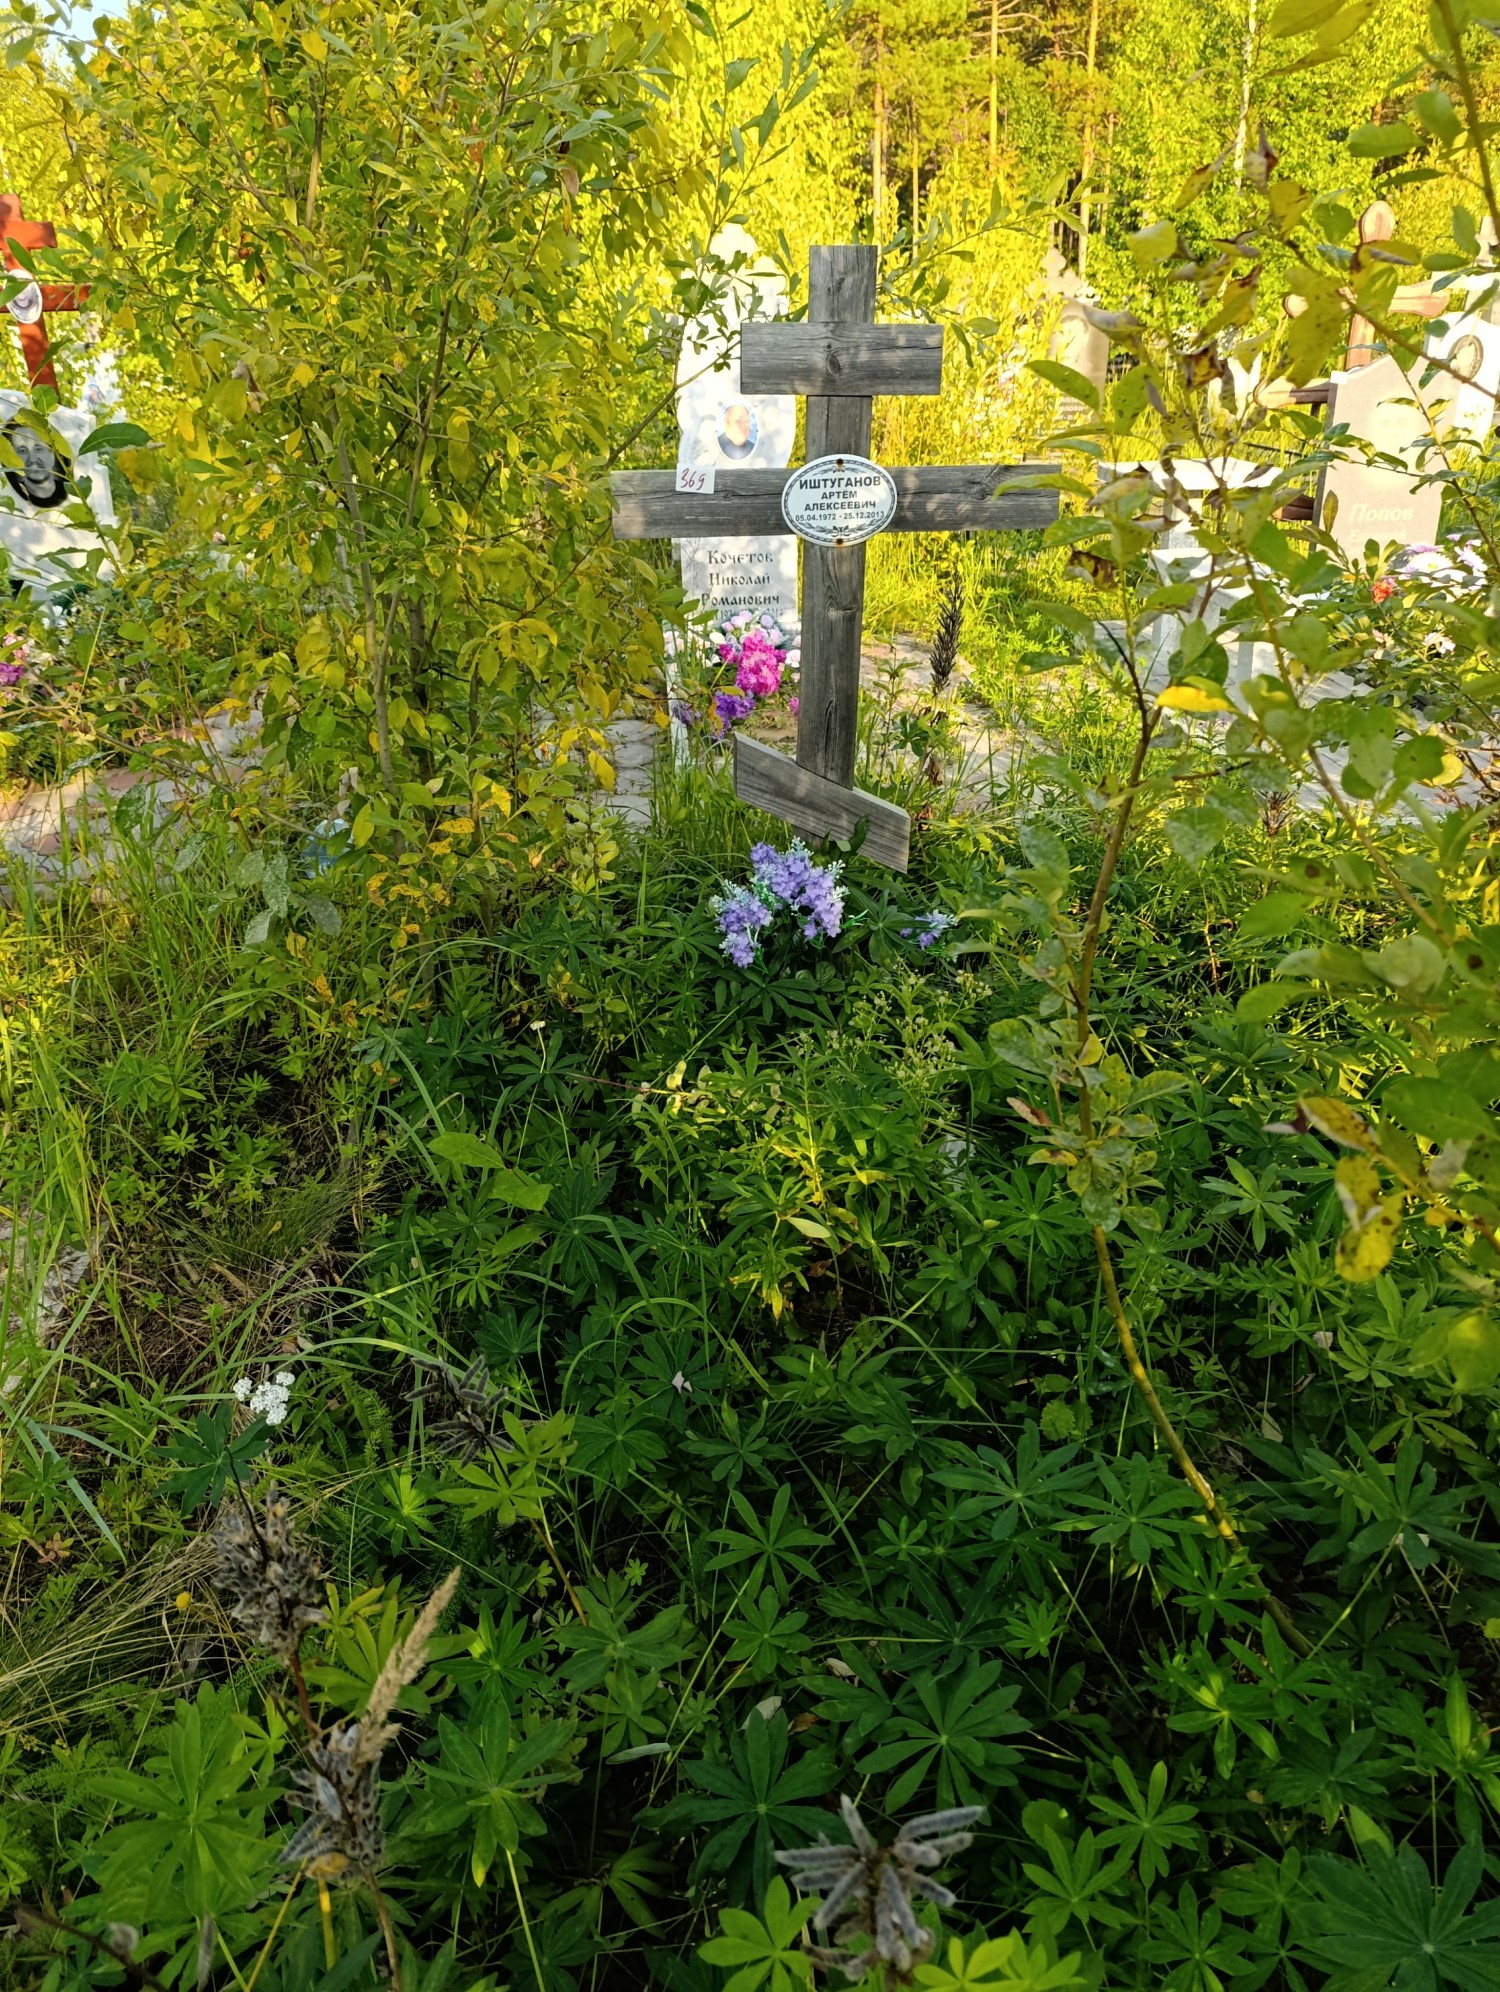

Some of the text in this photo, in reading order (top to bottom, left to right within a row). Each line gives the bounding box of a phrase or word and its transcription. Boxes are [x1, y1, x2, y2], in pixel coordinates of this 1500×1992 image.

[680, 467, 707, 491] 369
[799, 476, 881, 490] ИШТУГАНОВ
[804, 501, 876, 512] АЛЕКСЕЕВИЧ
[795, 513, 837, 522] 05.04.1972
[843, 511, 885, 520] 25.12.2013
[1349, 503, 1415, 525] Попов
[707, 550, 774, 565] Кочетов
[709, 573, 771, 586] Николай
[701, 593, 780, 607] Романович
